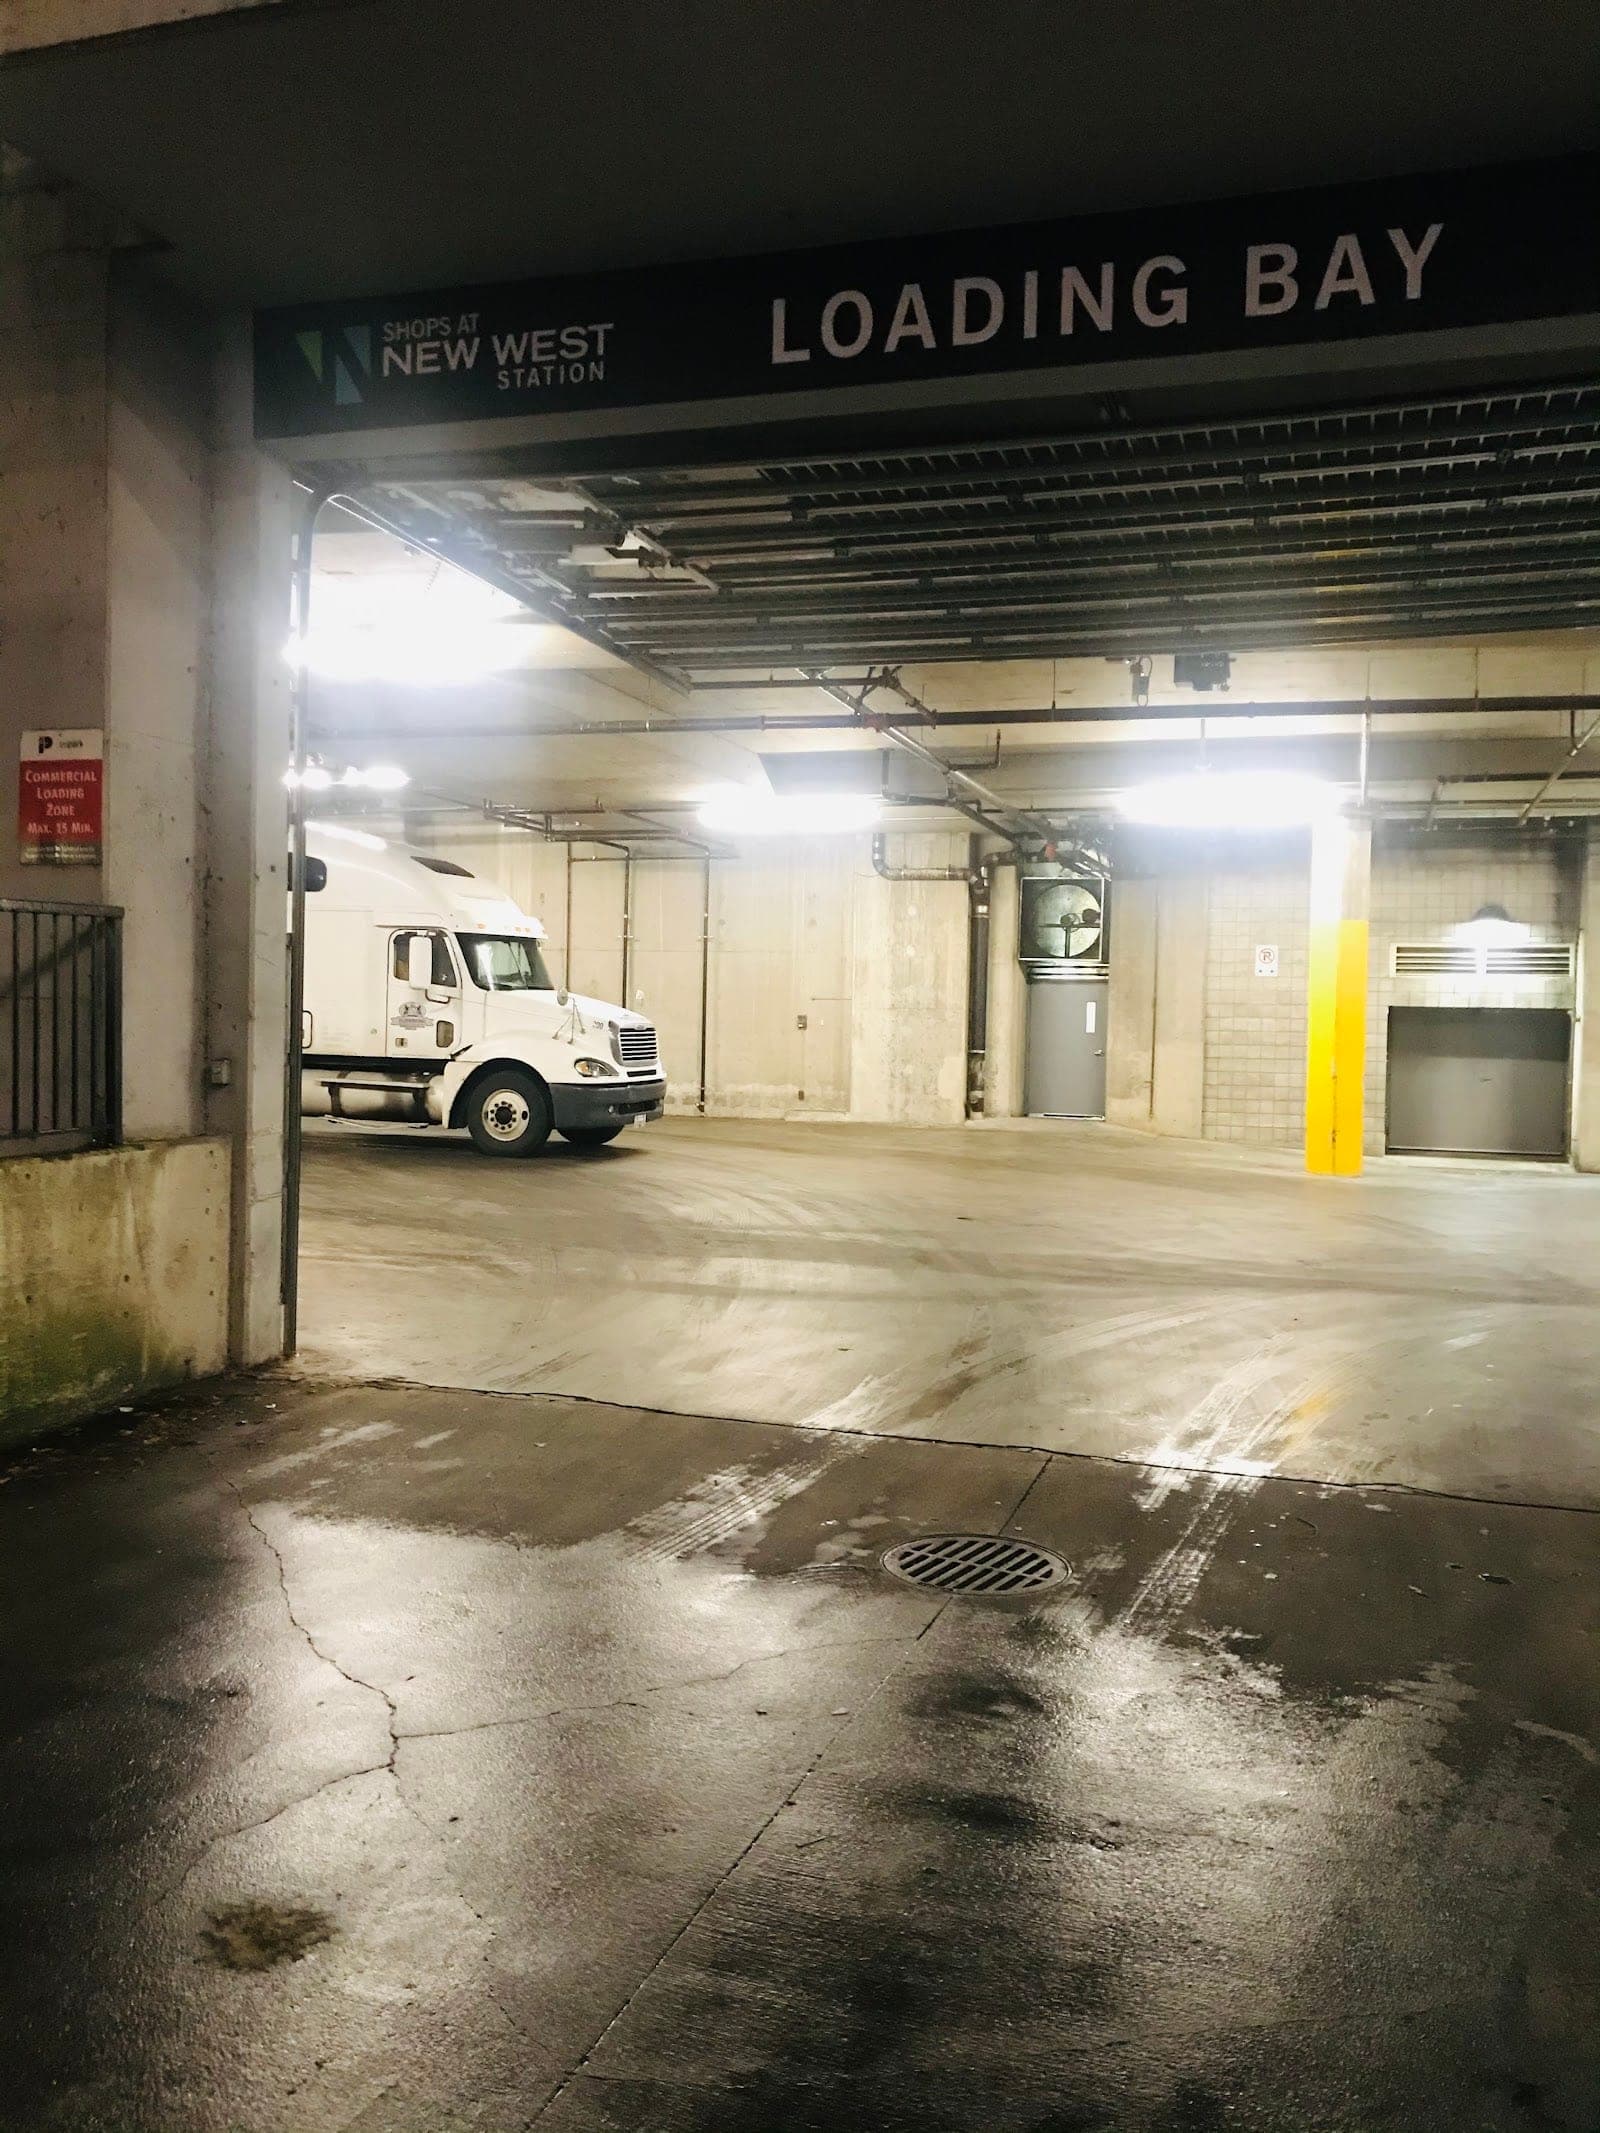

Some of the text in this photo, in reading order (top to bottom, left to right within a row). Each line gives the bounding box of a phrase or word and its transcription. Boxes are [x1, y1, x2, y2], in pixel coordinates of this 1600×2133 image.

[771, 224, 1444, 364] LOADING BAY
[382, 313, 480, 342] SHOPS AT
[382, 324, 614, 377] NEW WEST
[497, 361, 604, 390] STATION
[25, 770, 97, 783] COMMERCIAL
[36, 788, 85, 800] LOADING
[46, 803, 75, 817] ZONE
[56, 823, 68, 834] 15
